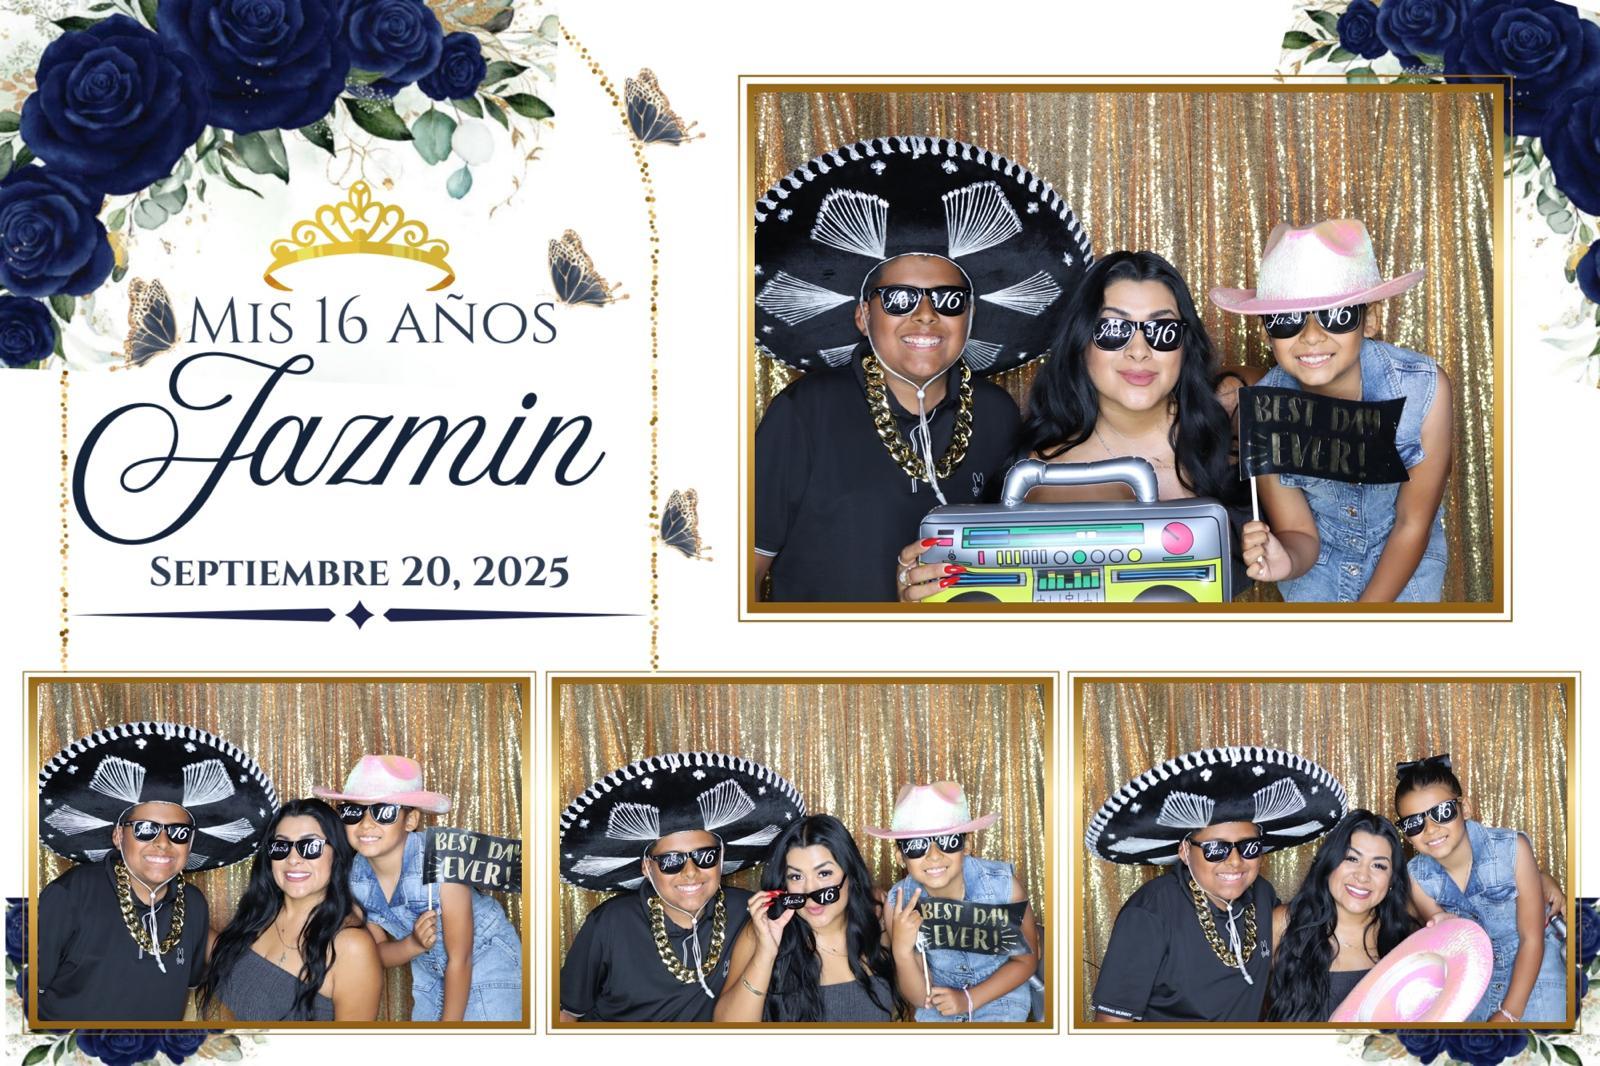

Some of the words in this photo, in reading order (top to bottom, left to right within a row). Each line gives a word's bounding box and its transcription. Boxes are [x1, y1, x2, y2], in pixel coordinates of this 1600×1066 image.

[938, 291, 963, 310] 16
[1153, 322, 1178, 347] 16
[1254, 395, 1316, 427] BEST
[1271, 432, 1368, 478] EVER!
[171, 827, 190, 840] 16
[435, 832, 480, 856] BEST
[698, 849, 716, 865] 16
[1242, 841, 1261, 857] 16
[444, 856, 512, 889] EVER!
[819, 888, 835, 904] 16
[920, 902, 964, 922] BEST
[973, 907, 1009, 928] DAY
[933, 924, 999, 952] EVER!
